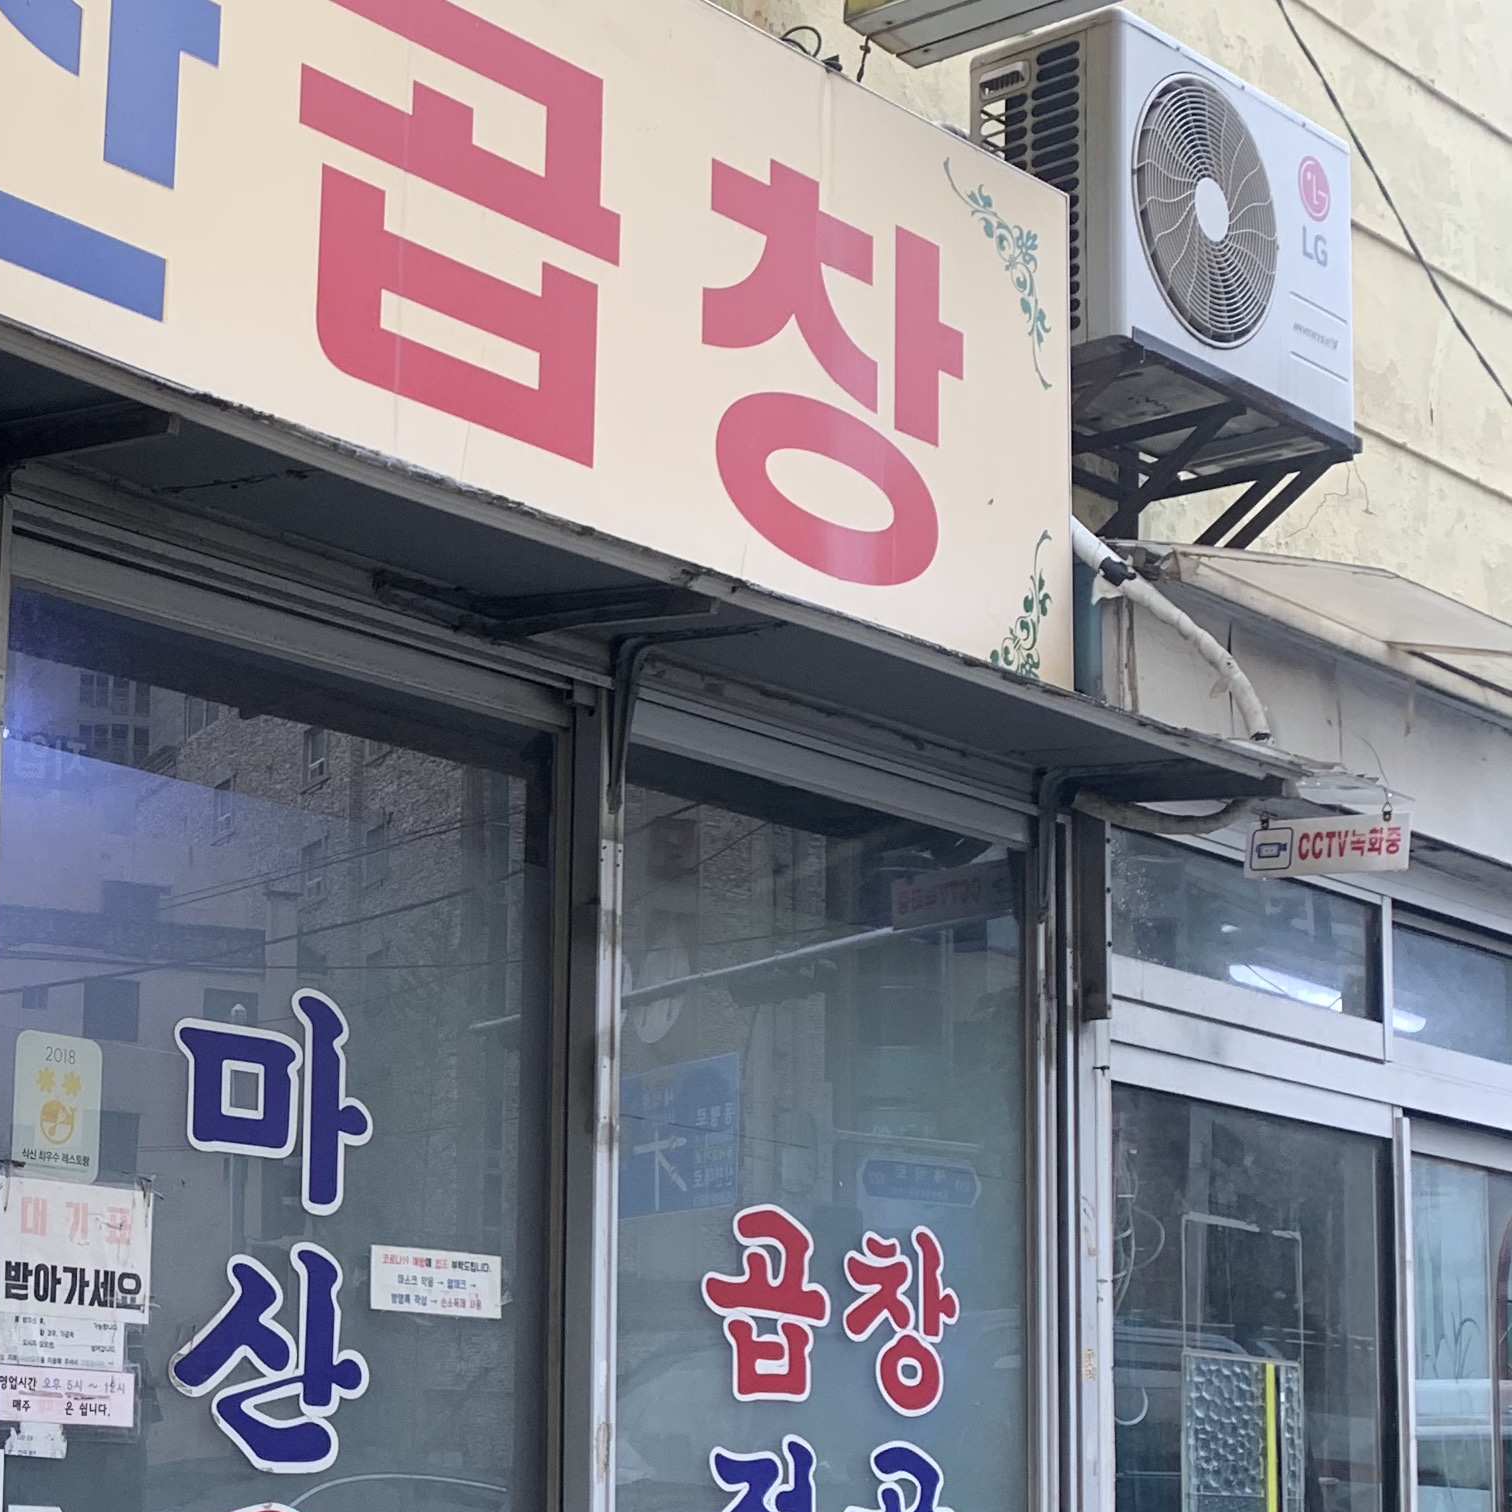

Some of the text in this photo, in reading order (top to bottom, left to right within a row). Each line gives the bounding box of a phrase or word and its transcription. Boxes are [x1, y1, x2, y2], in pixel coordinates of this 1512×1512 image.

[1302, 225, 1327, 267] LG
[45, 1046, 76, 1065] 2018
[38, 1150, 60, 1163] 최우수
[61, 1152, 90, 1167] 레스토랑
[4, 1260, 145, 1311] 받아가세요
[702, 1204, 960, 1417] 곱창
[42, 1377, 61, 1389] 오후
[66, 1379, 83, 1391] 5시
[12, 1399, 31, 1412] 매주
